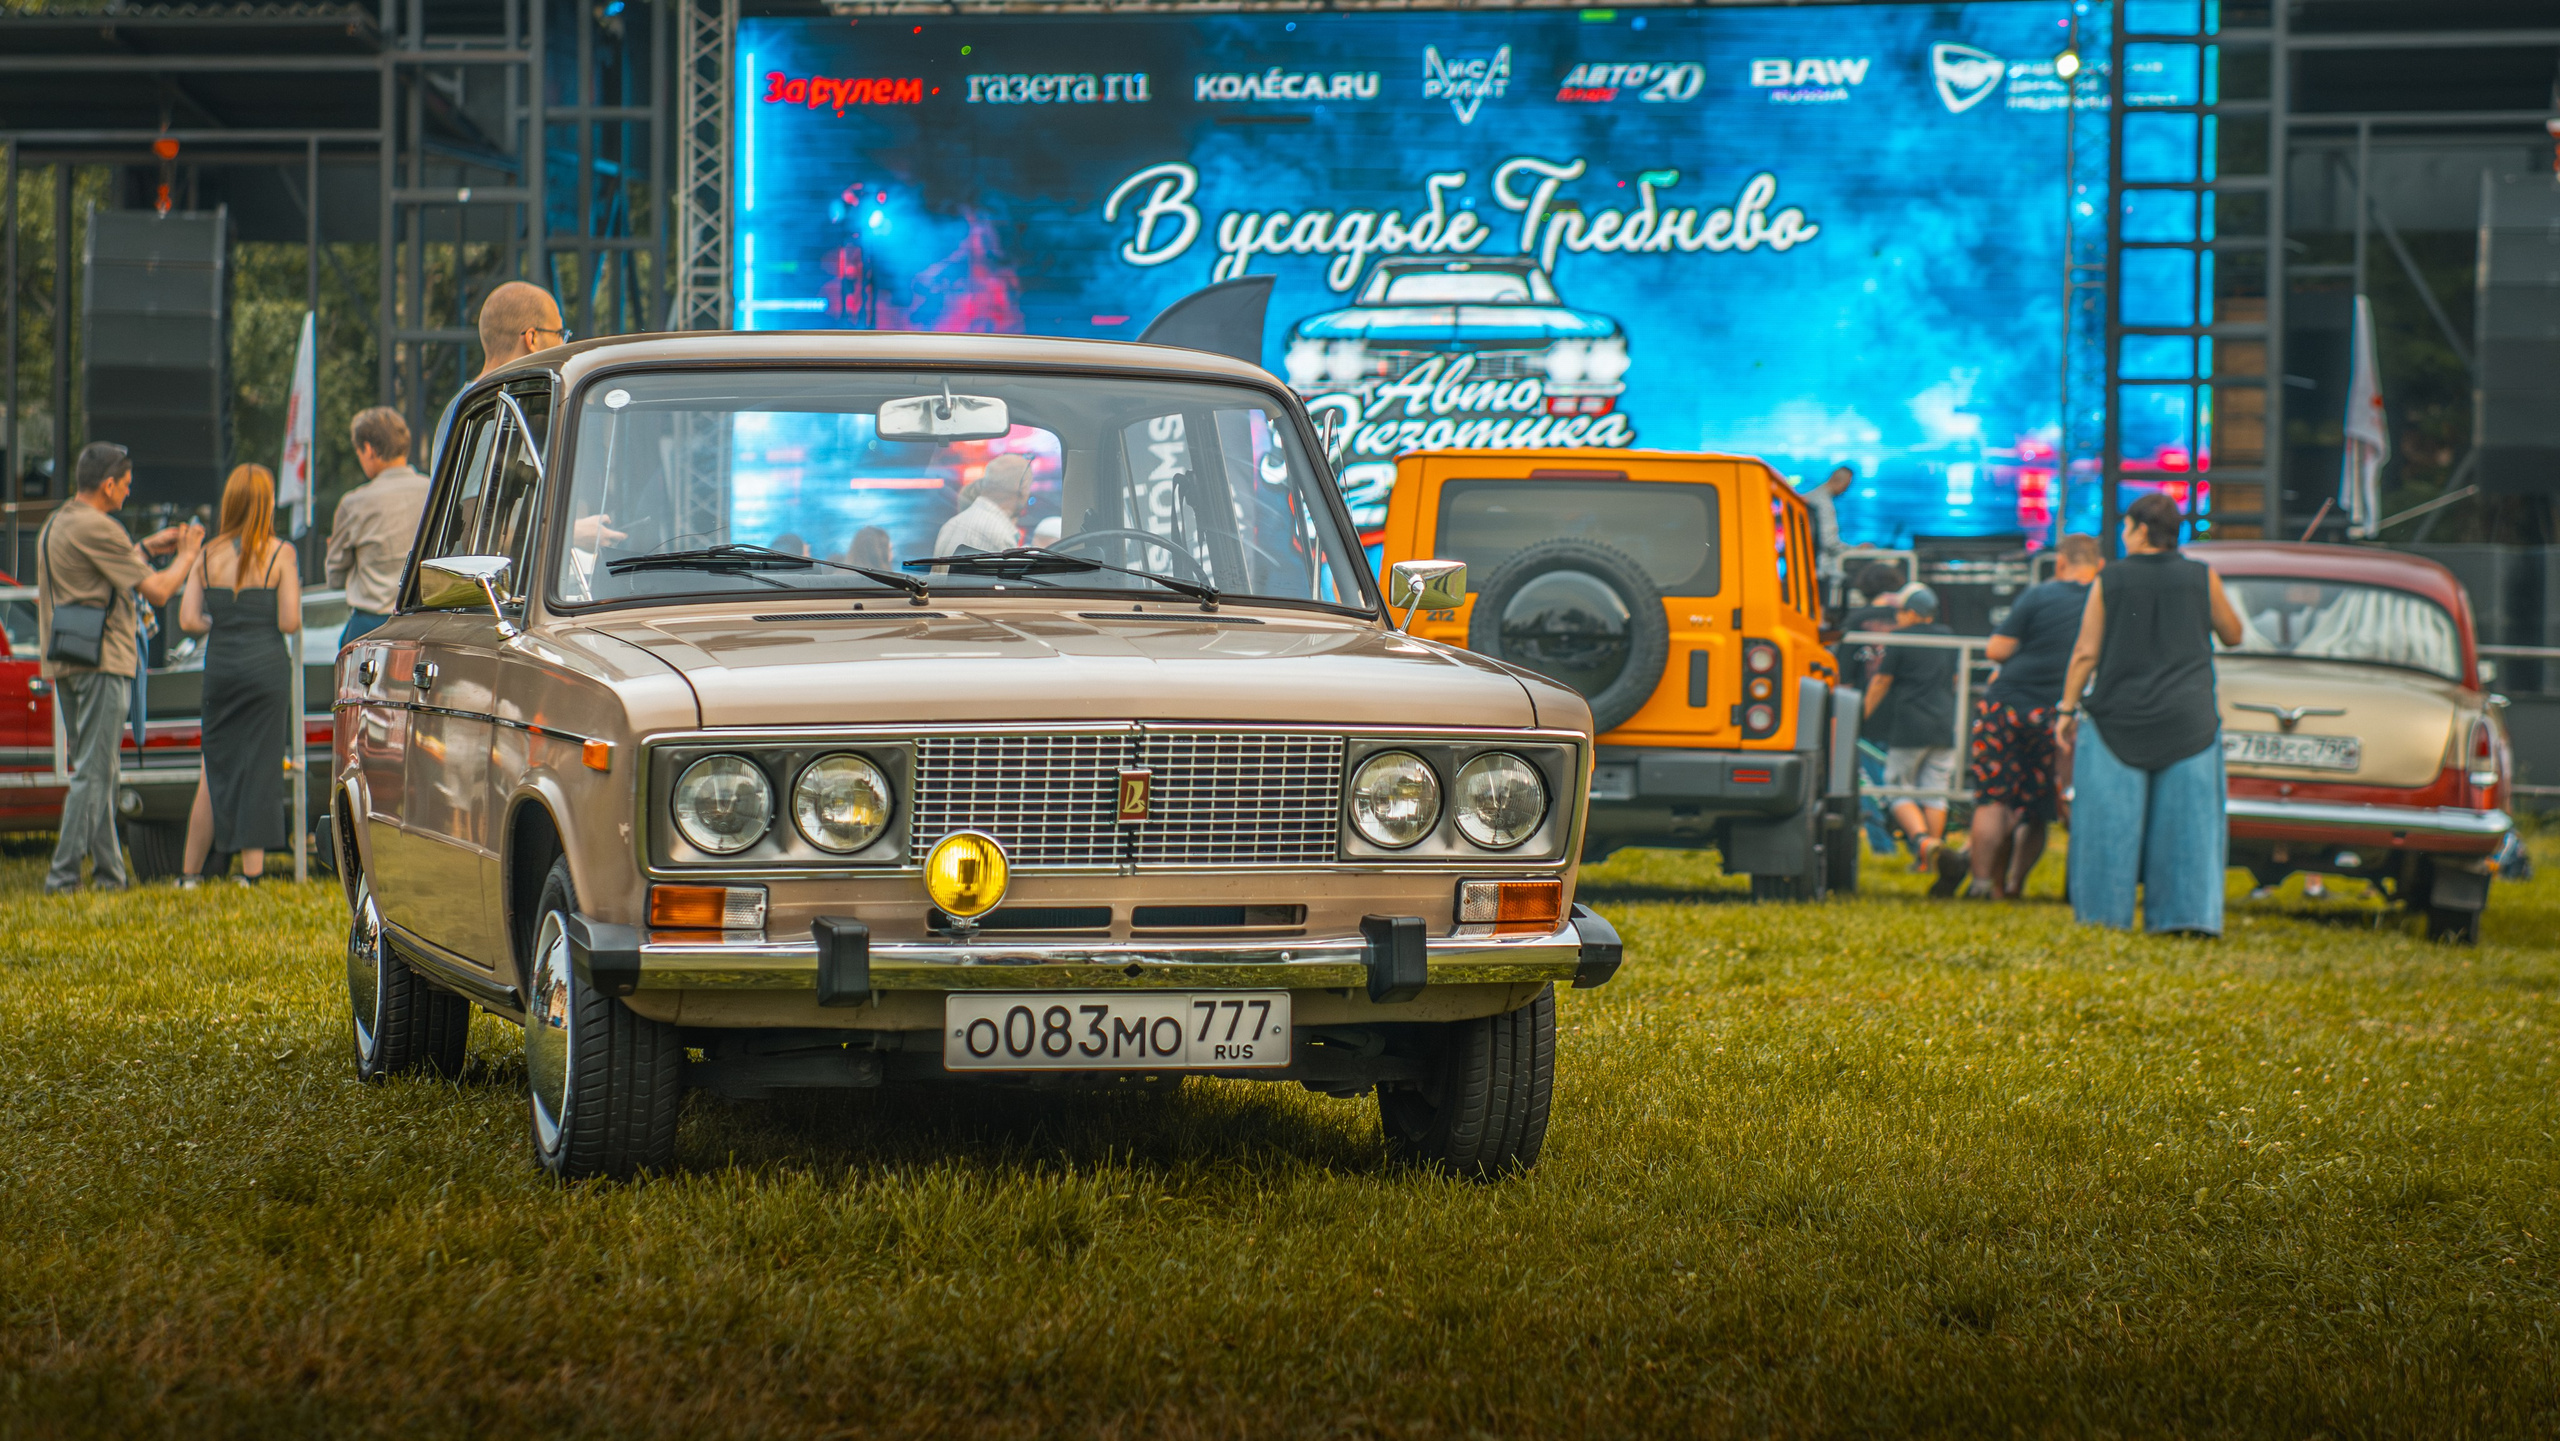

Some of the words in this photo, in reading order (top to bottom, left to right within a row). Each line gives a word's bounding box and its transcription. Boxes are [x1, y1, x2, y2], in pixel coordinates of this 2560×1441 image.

[1561, 63, 1650, 87] АВТО
[1750, 58, 1870, 86] BAW
[966, 73, 1151, 104] газета.ru
[1103, 162, 1198, 265] В
[1213, 171, 1489, 292] усадьбе
[1364, 353, 1543, 418] Авто
[965, 1003, 1183, 1059] О083МО
[1193, 1000, 1273, 1042] 777
[1214, 1044, 1254, 1060] RUS
